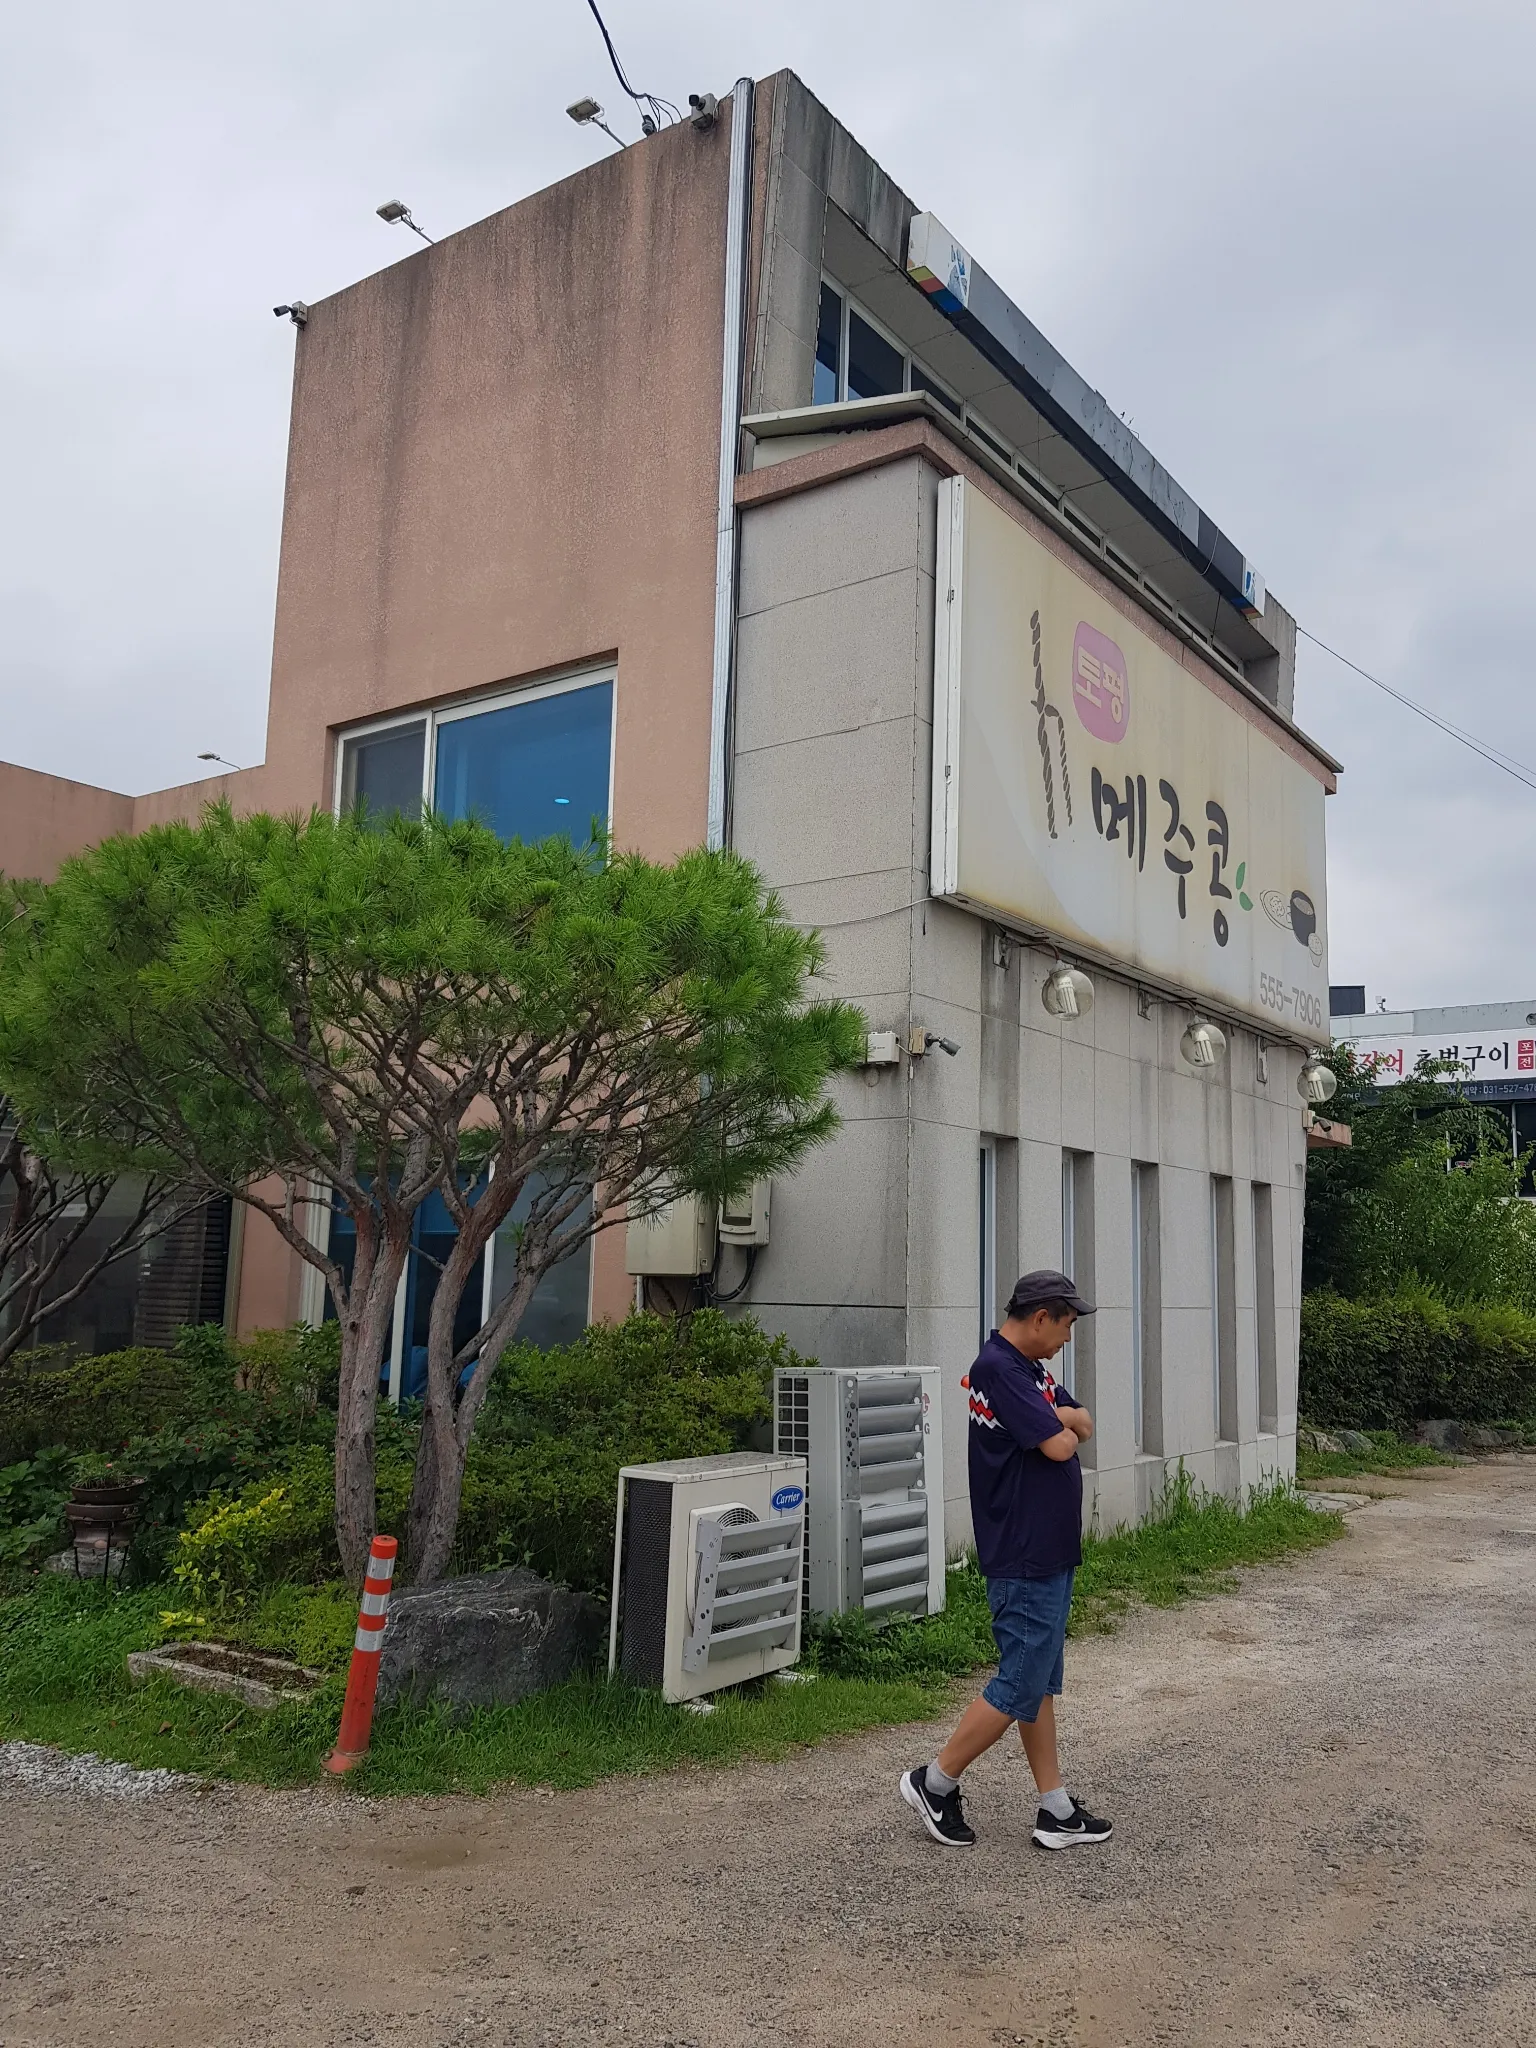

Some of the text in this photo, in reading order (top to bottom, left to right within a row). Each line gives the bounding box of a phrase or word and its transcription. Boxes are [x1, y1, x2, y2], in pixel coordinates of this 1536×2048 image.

[1075, 645, 1125, 725] 토평
[1091, 766, 1232, 948] 메주콩
[1259, 972, 1322, 1029] 555-7906
[775, 1491, 801, 1505] Carrier
